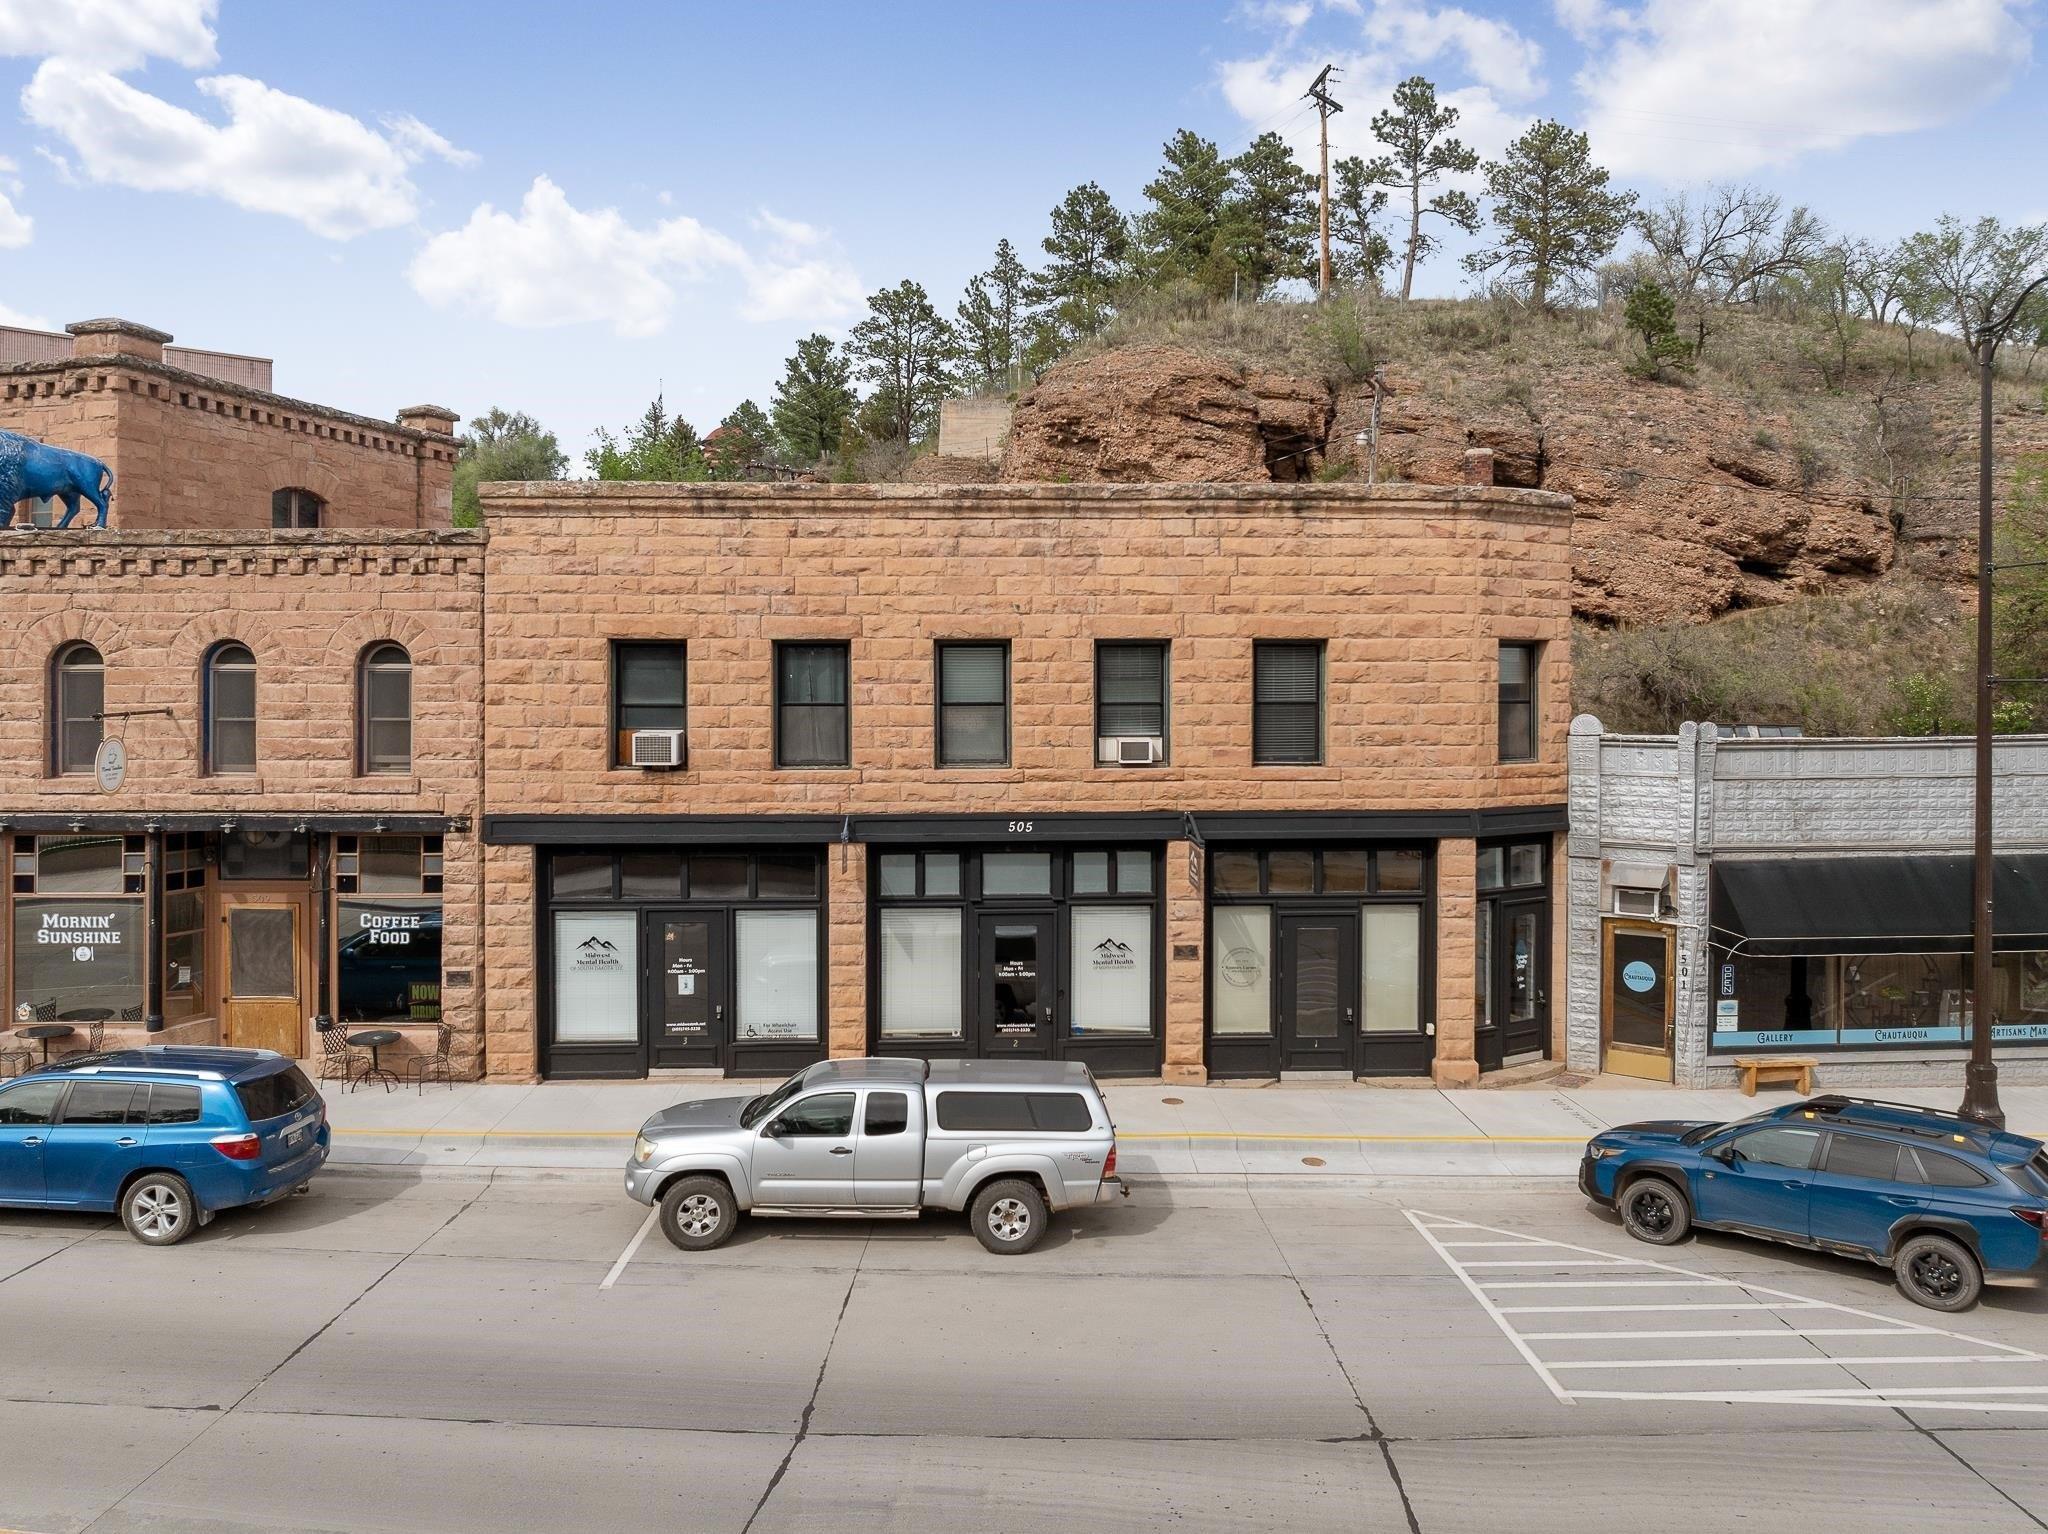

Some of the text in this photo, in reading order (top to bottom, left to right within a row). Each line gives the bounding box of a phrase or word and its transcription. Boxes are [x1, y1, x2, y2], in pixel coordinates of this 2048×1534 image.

[1008, 821, 1033, 833] 505
[360, 913, 420, 928] COFFEE
[37, 929, 121, 944] SUNSHINE
[369, 929, 410, 944] FOOD
[1680, 954, 1689, 990] 501
[1723, 966, 1733, 993] OPEN
[411, 984, 440, 1000] NOW
[410, 1005, 440, 1019] HIRING
[682, 1037, 688, 1045] 3
[1757, 1032, 1794, 1044] GALLERY
[1874, 1029, 1928, 1042] CHAUTAUQUA
[1012, 1039, 1019, 1048] 2
